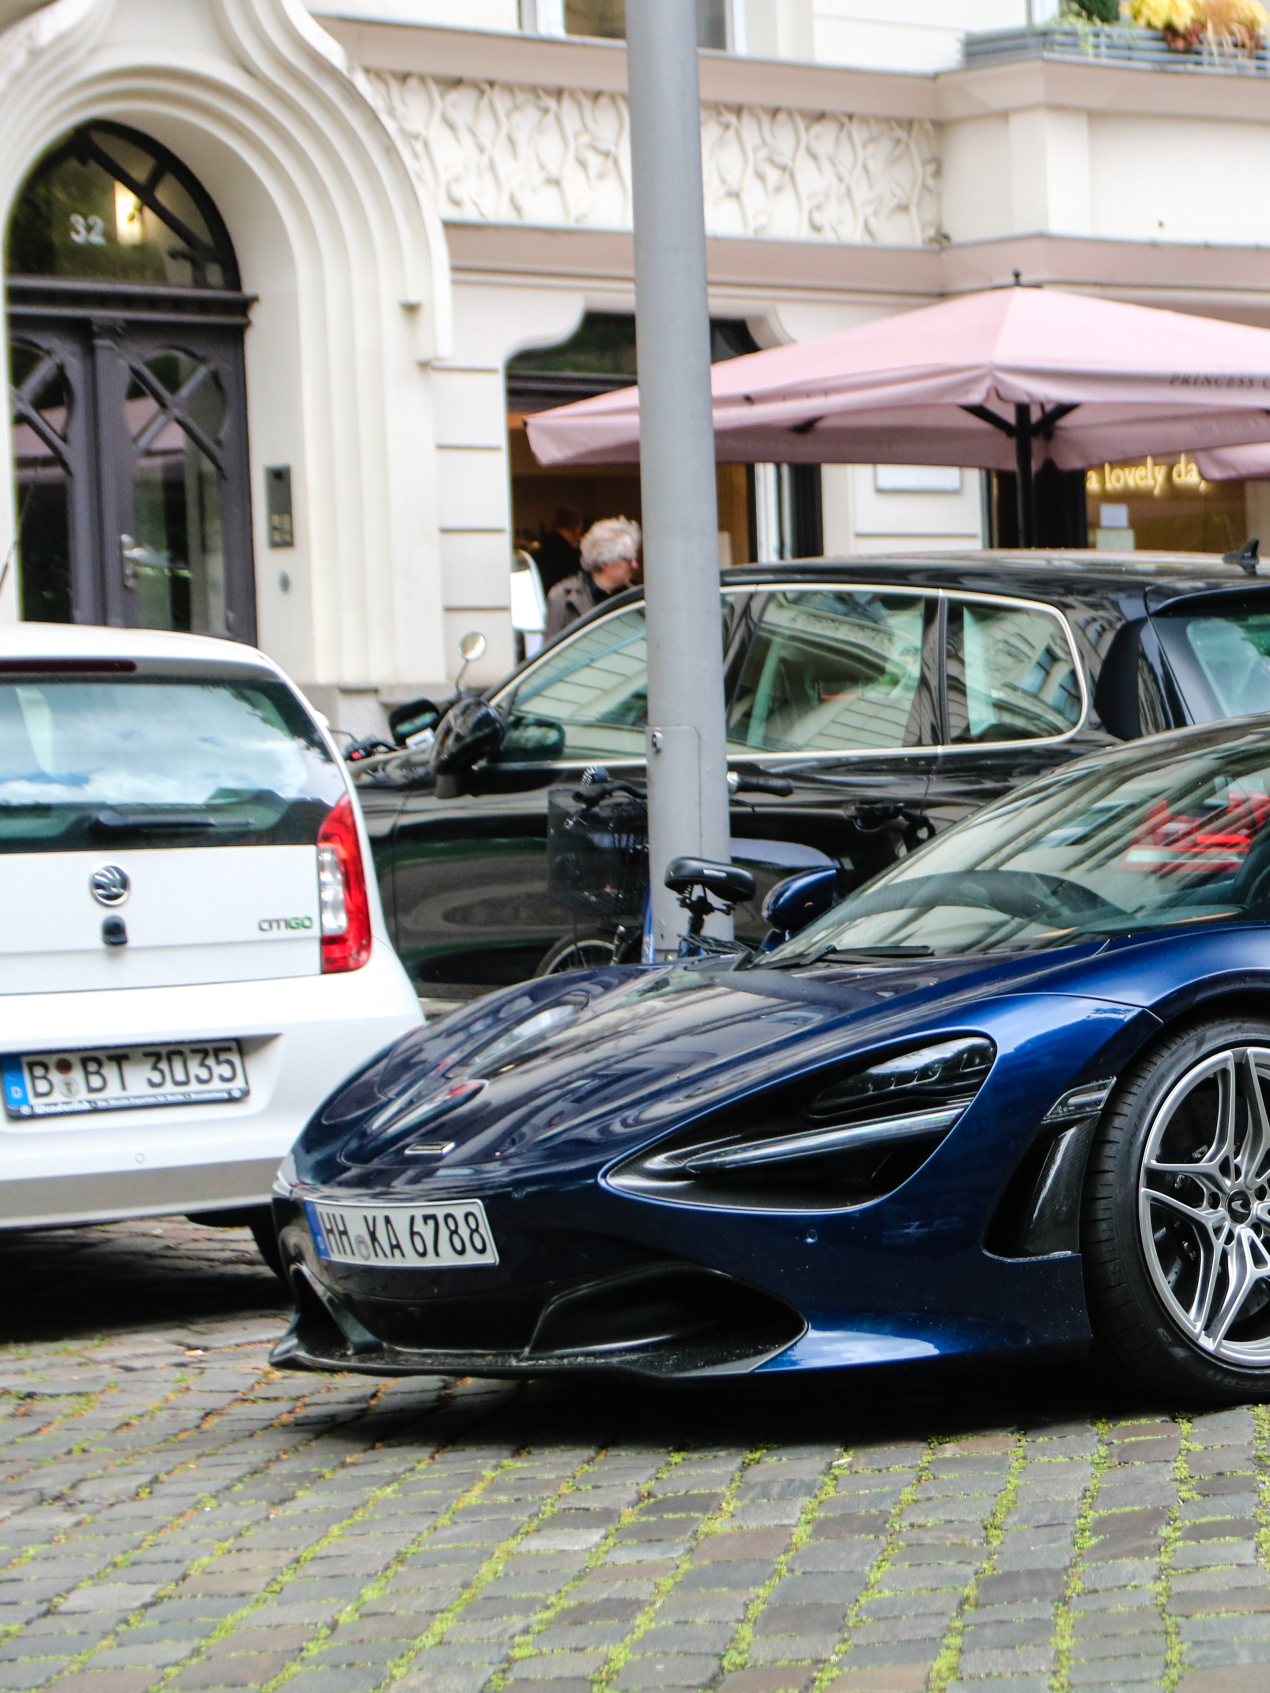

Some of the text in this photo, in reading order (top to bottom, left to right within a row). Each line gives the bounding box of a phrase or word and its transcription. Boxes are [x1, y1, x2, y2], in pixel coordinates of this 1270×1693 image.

[70, 213, 106, 245] 32
[1169, 374, 1254, 387] PRINCESS
[1086, 470, 1101, 491] a
[1105, 454, 1167, 497] lovely
[26, 1061, 54, 1098] B
[80, 1053, 130, 1094] BT
[143, 1046, 238, 1088] 3035
[319, 1211, 355, 1257] HH
[363, 1214, 406, 1258] KA
[410, 1211, 487, 1258] 6788
